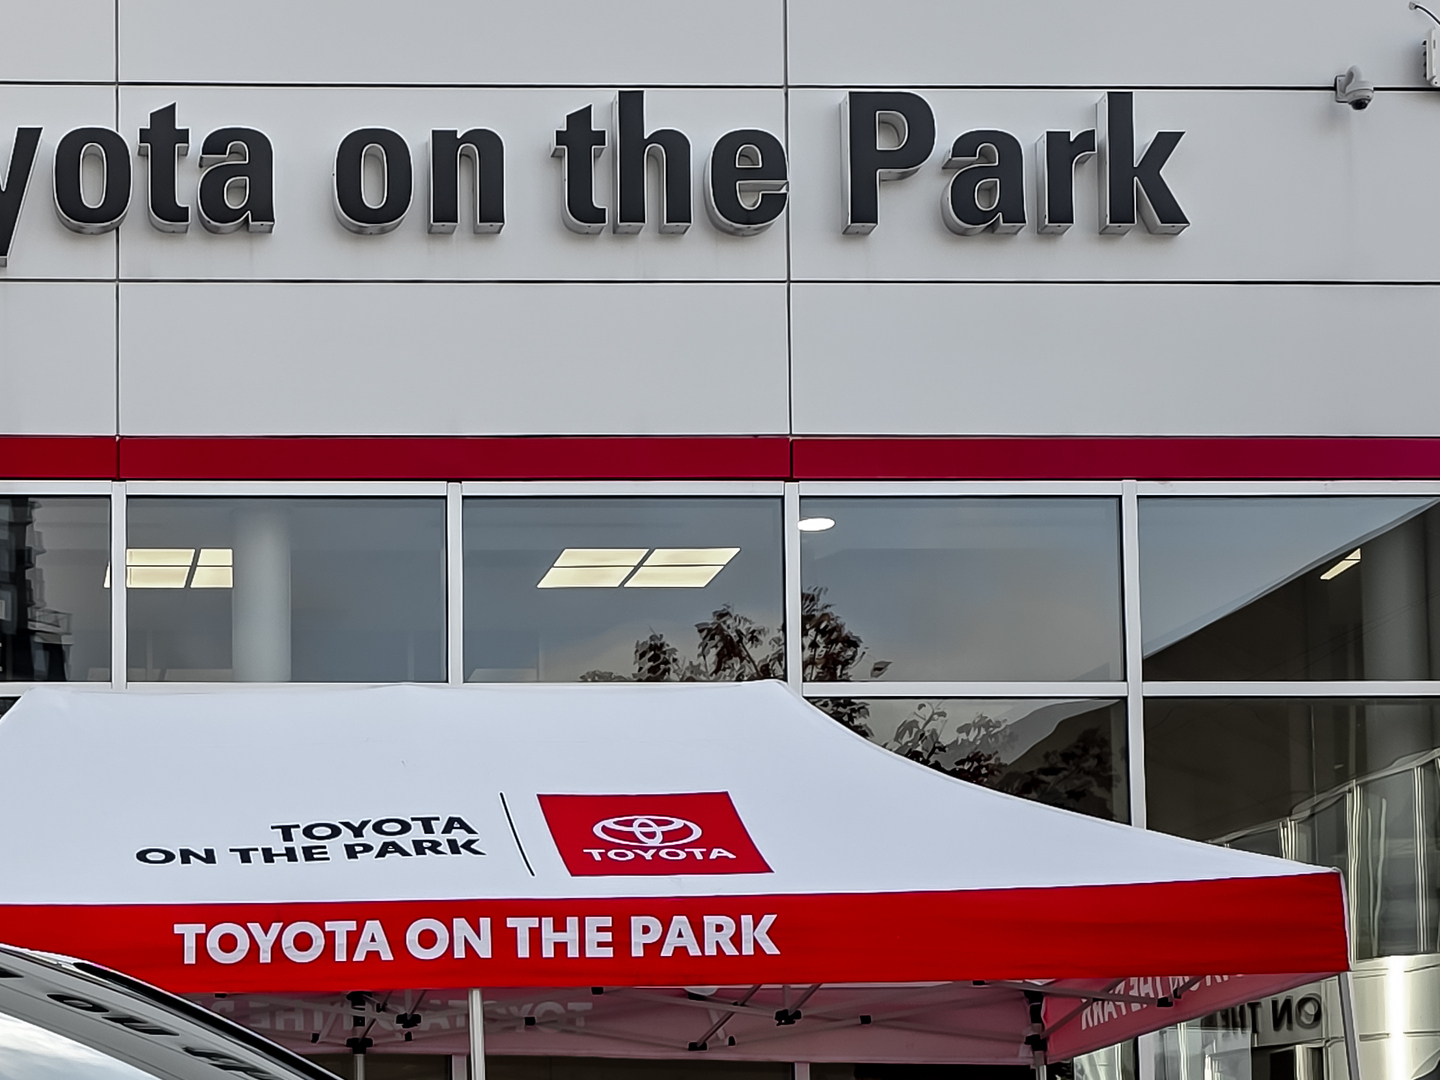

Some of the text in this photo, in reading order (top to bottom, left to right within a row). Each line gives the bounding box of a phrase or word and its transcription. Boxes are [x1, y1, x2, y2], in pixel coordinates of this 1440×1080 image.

[333, 127, 506, 235] on
[550, 90, 789, 236] the
[840, 90, 1190, 236] Park
[271, 816, 478, 842] TOYOTA
[135, 838, 487, 865] ON THE PARK
[583, 848, 736, 861] TOYOTA
[174, 914, 781, 965] TOYOTA ON THE PARK
